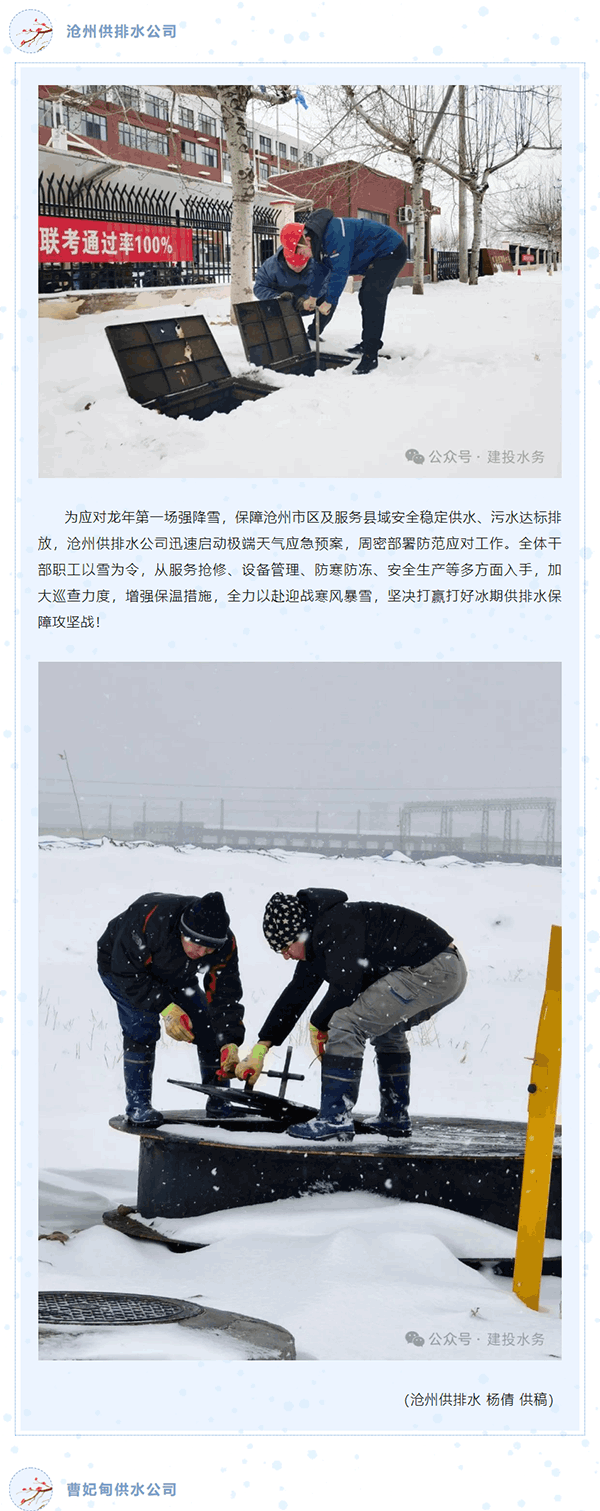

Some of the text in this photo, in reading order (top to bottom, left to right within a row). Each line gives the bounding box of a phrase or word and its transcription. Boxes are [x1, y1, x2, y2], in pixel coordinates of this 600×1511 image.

[39, 226, 173, 256] 联考通过率100%
